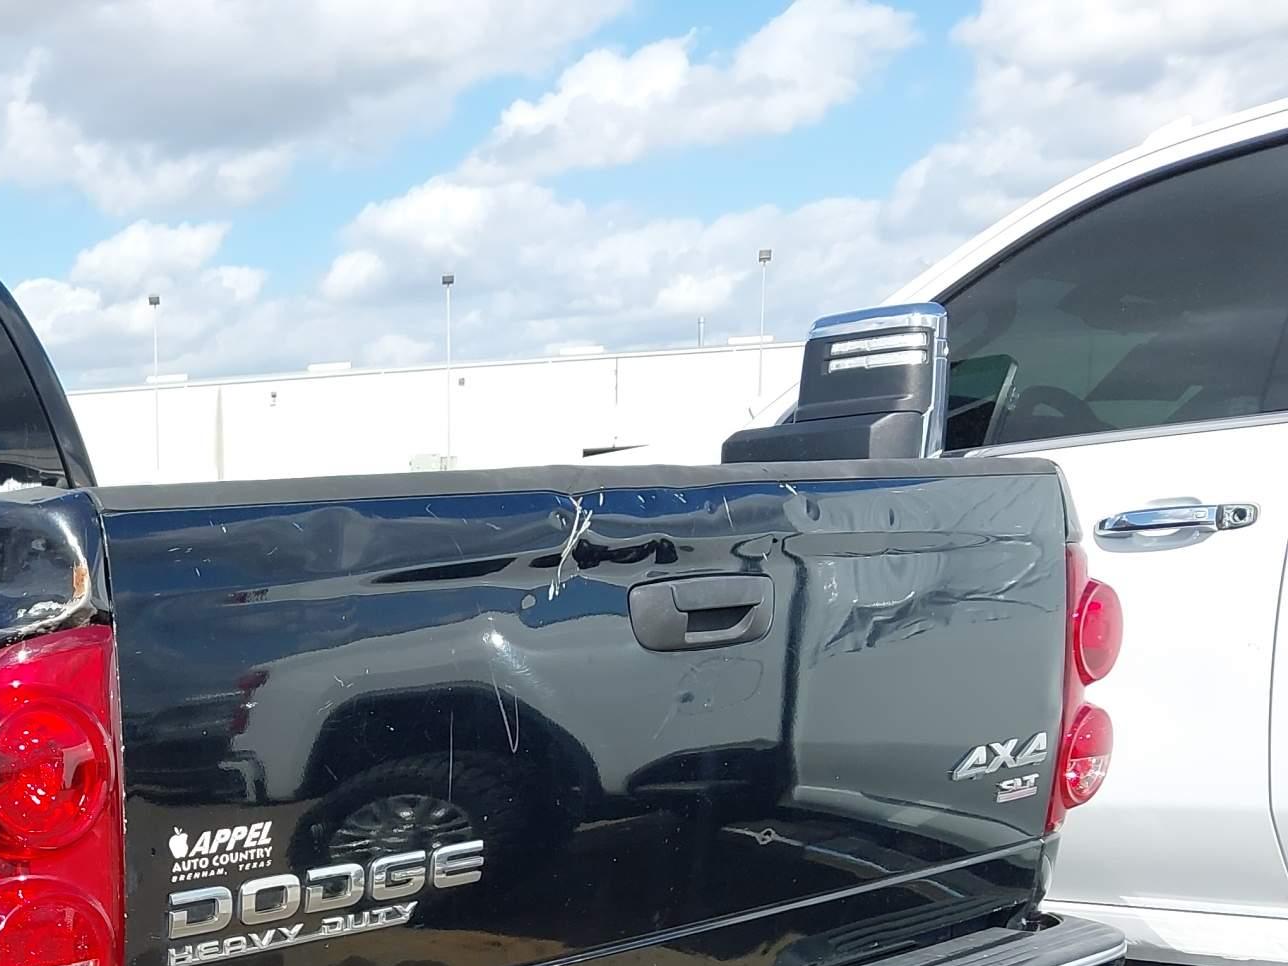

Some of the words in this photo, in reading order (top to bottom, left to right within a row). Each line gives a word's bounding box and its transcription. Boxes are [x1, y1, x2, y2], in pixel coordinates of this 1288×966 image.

[189, 820, 273, 857] APPEL
[172, 857, 209, 872] AUTO
[212, 846, 273, 867] COUNTRY
[238, 859, 273, 872] TEXAS
[168, 839, 485, 939] DODGE
[320, 901, 419, 937] DUTY
